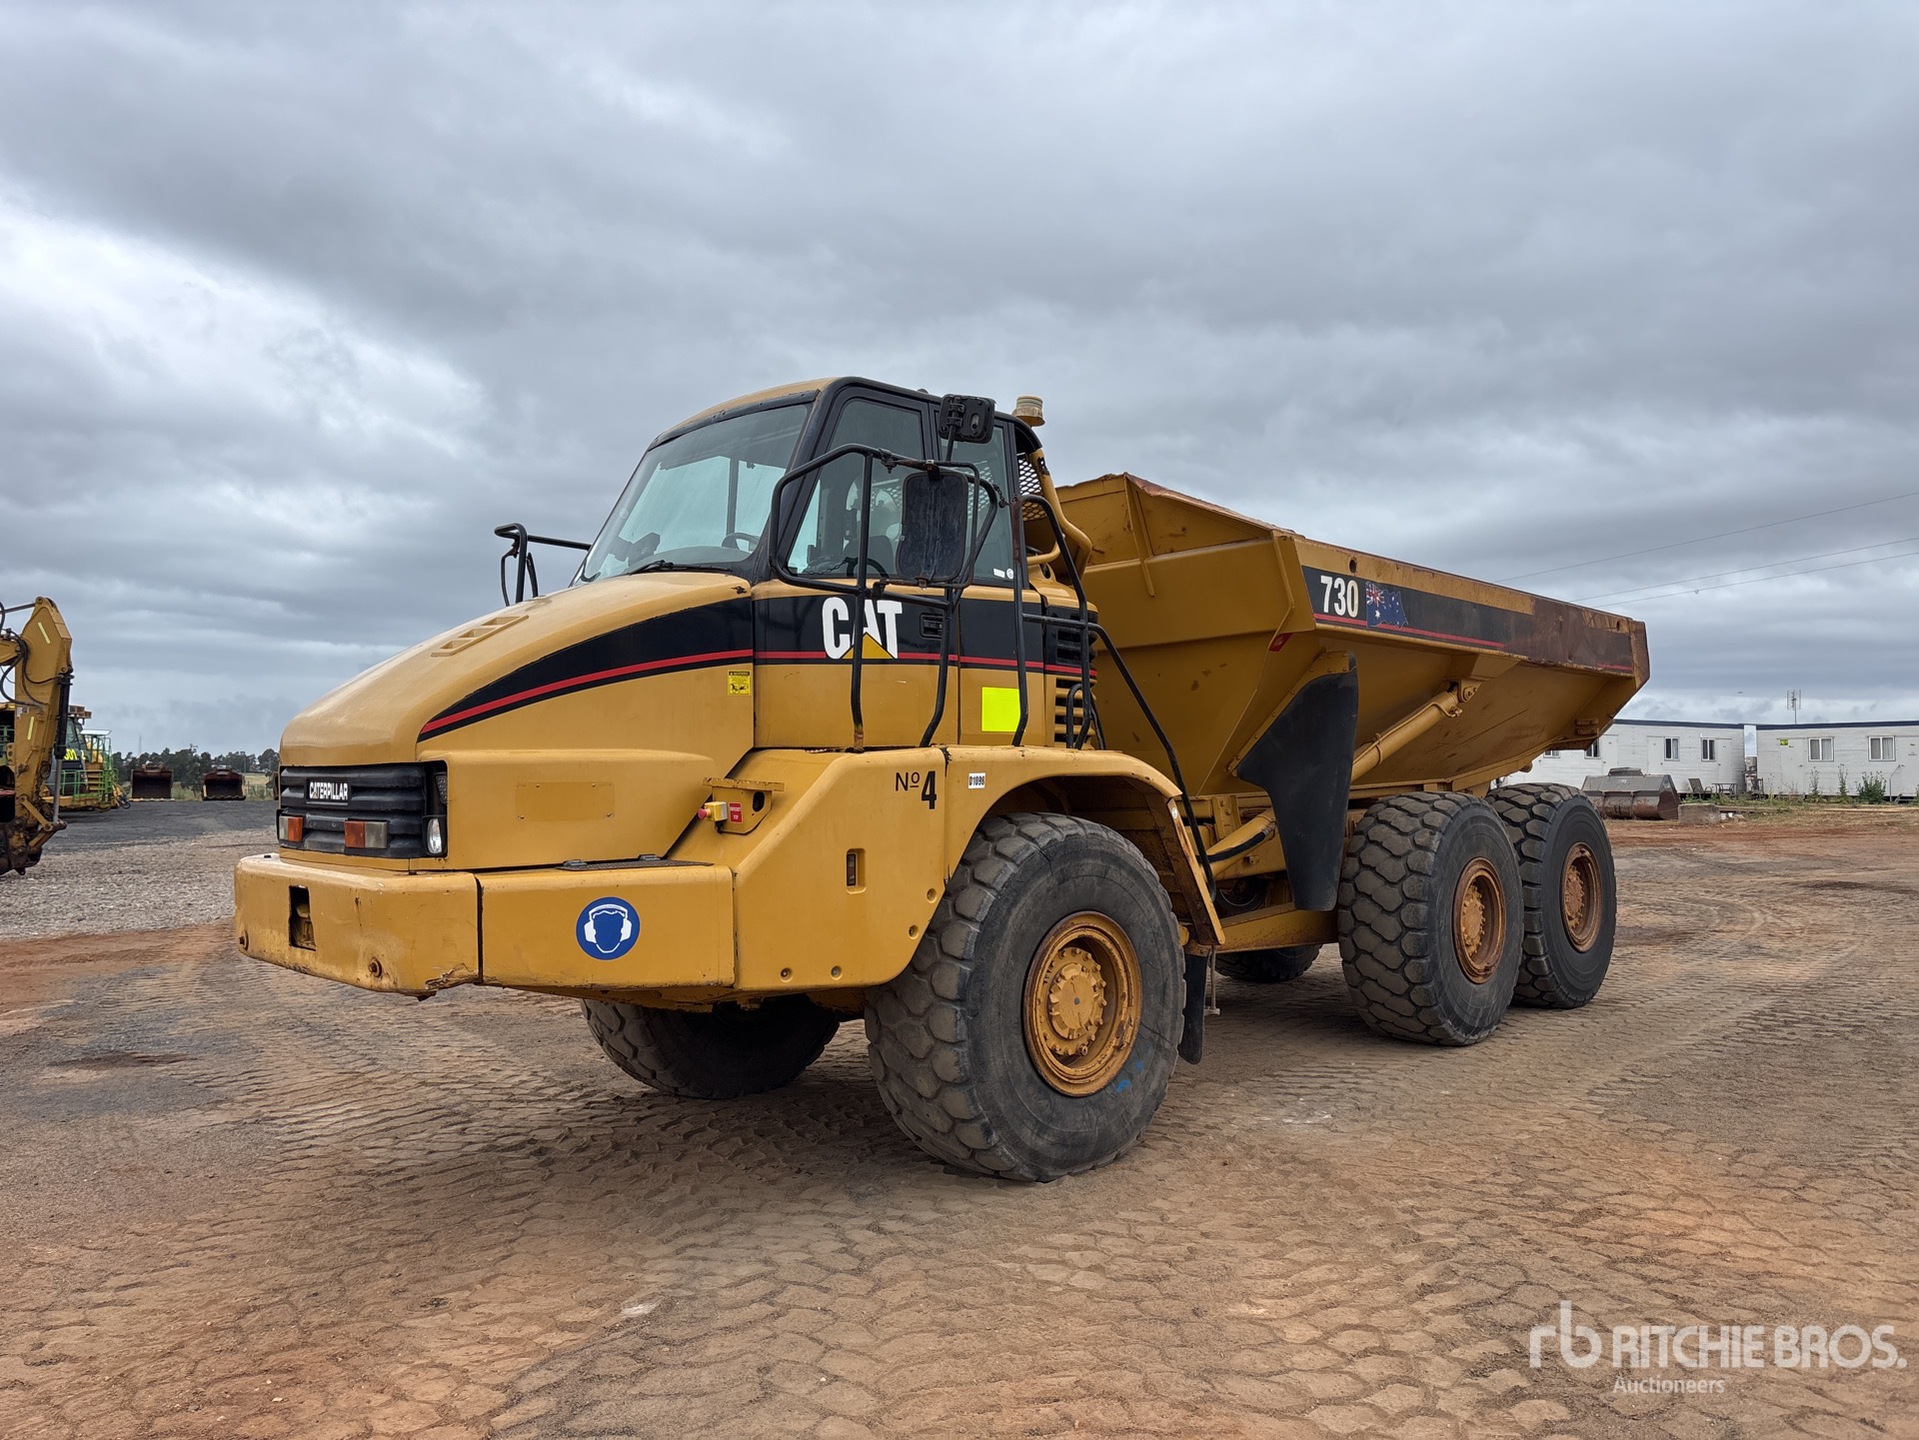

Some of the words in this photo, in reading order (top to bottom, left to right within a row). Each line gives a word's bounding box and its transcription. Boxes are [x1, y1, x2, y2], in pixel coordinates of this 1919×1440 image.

[1320, 575, 1359, 618] 730
[822, 597, 903, 659] CAT
[309, 781, 348, 800] CATERPILLAR
[921, 770, 937, 809] 4
